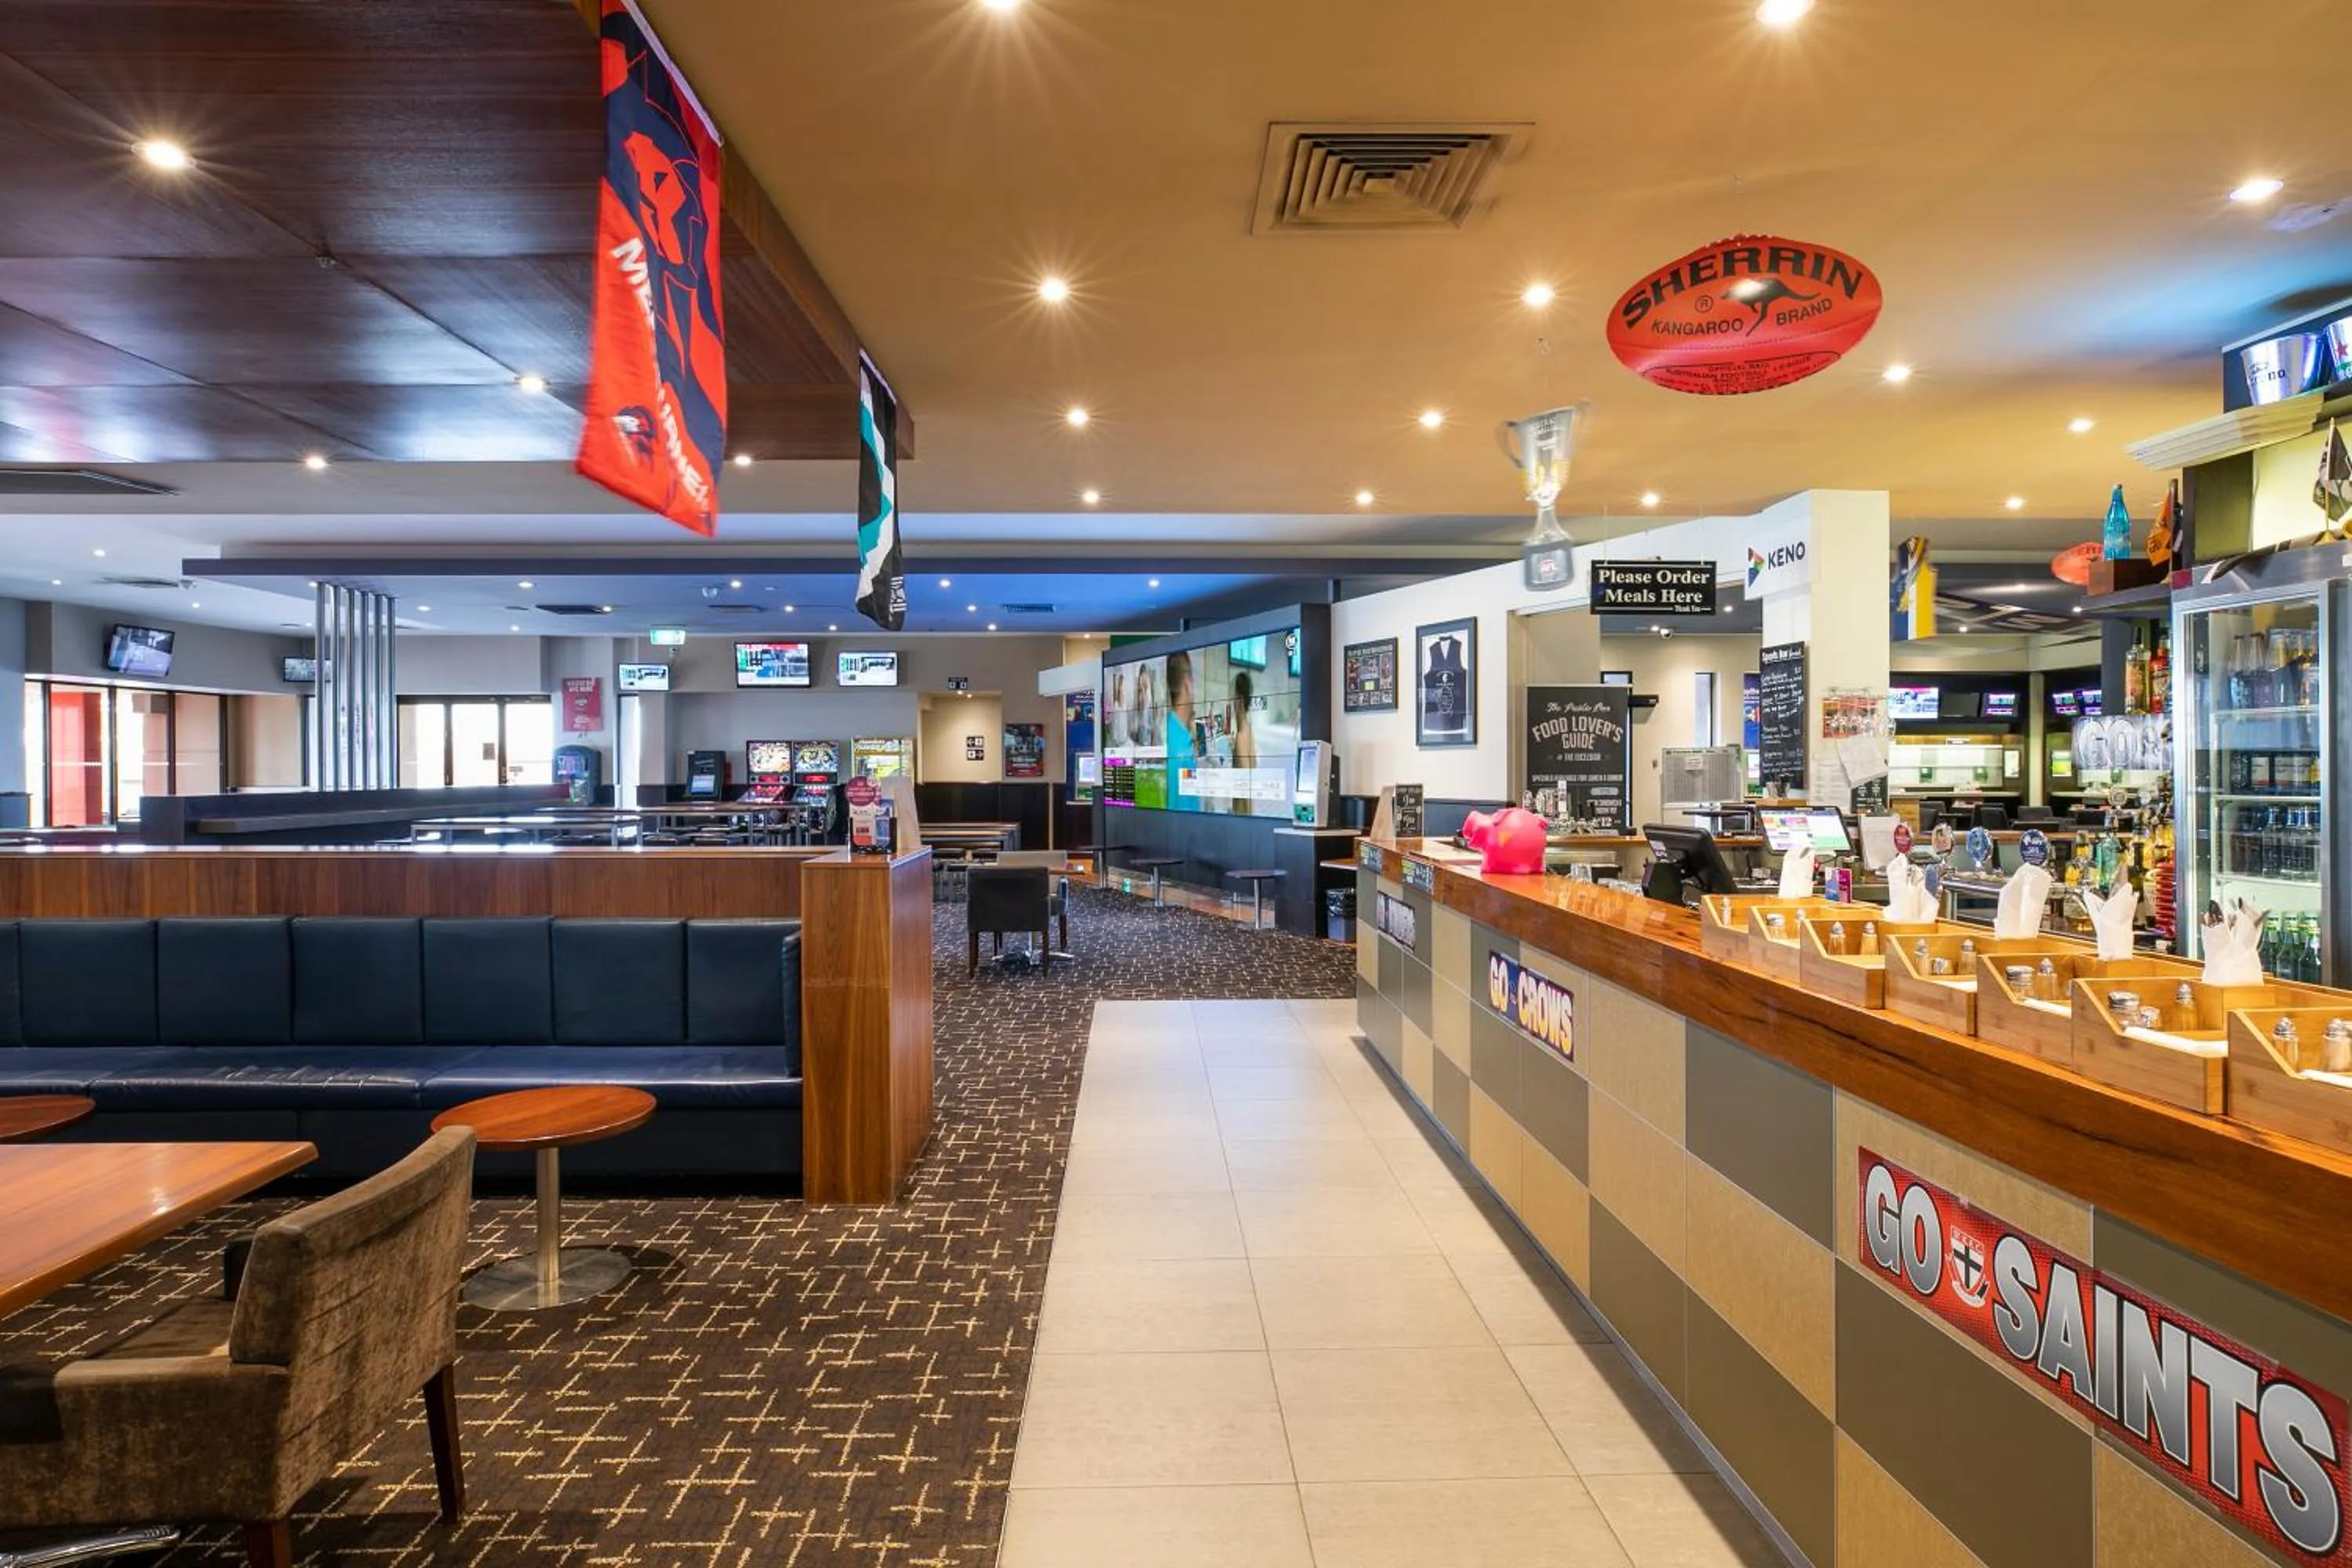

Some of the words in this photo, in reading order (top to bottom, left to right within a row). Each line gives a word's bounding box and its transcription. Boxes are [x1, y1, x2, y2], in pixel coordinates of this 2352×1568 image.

[1621, 246, 1863, 328] SHERRIN
[1652, 318, 1744, 336] KANGAROO
[1776, 298, 1833, 326] BRAND
[1768, 541, 1806, 571] KENO
[1598, 570, 1652, 584] Please
[1656, 570, 1710, 584] Order
[1605, 589, 1657, 603] Meals
[1661, 589, 1703, 603] Here
[1532, 717, 1568, 742] FOOD
[1572, 716, 1624, 743] LOVER'S
[1561, 733, 1596, 750] GUIDE
[2078, 720, 2137, 767] GO
[1490, 956, 1509, 1013] GO
[1518, 971, 1573, 1054] CROWS
[1864, 1162, 1944, 1298] GO
[1991, 1232, 2343, 1555] SAINTS
